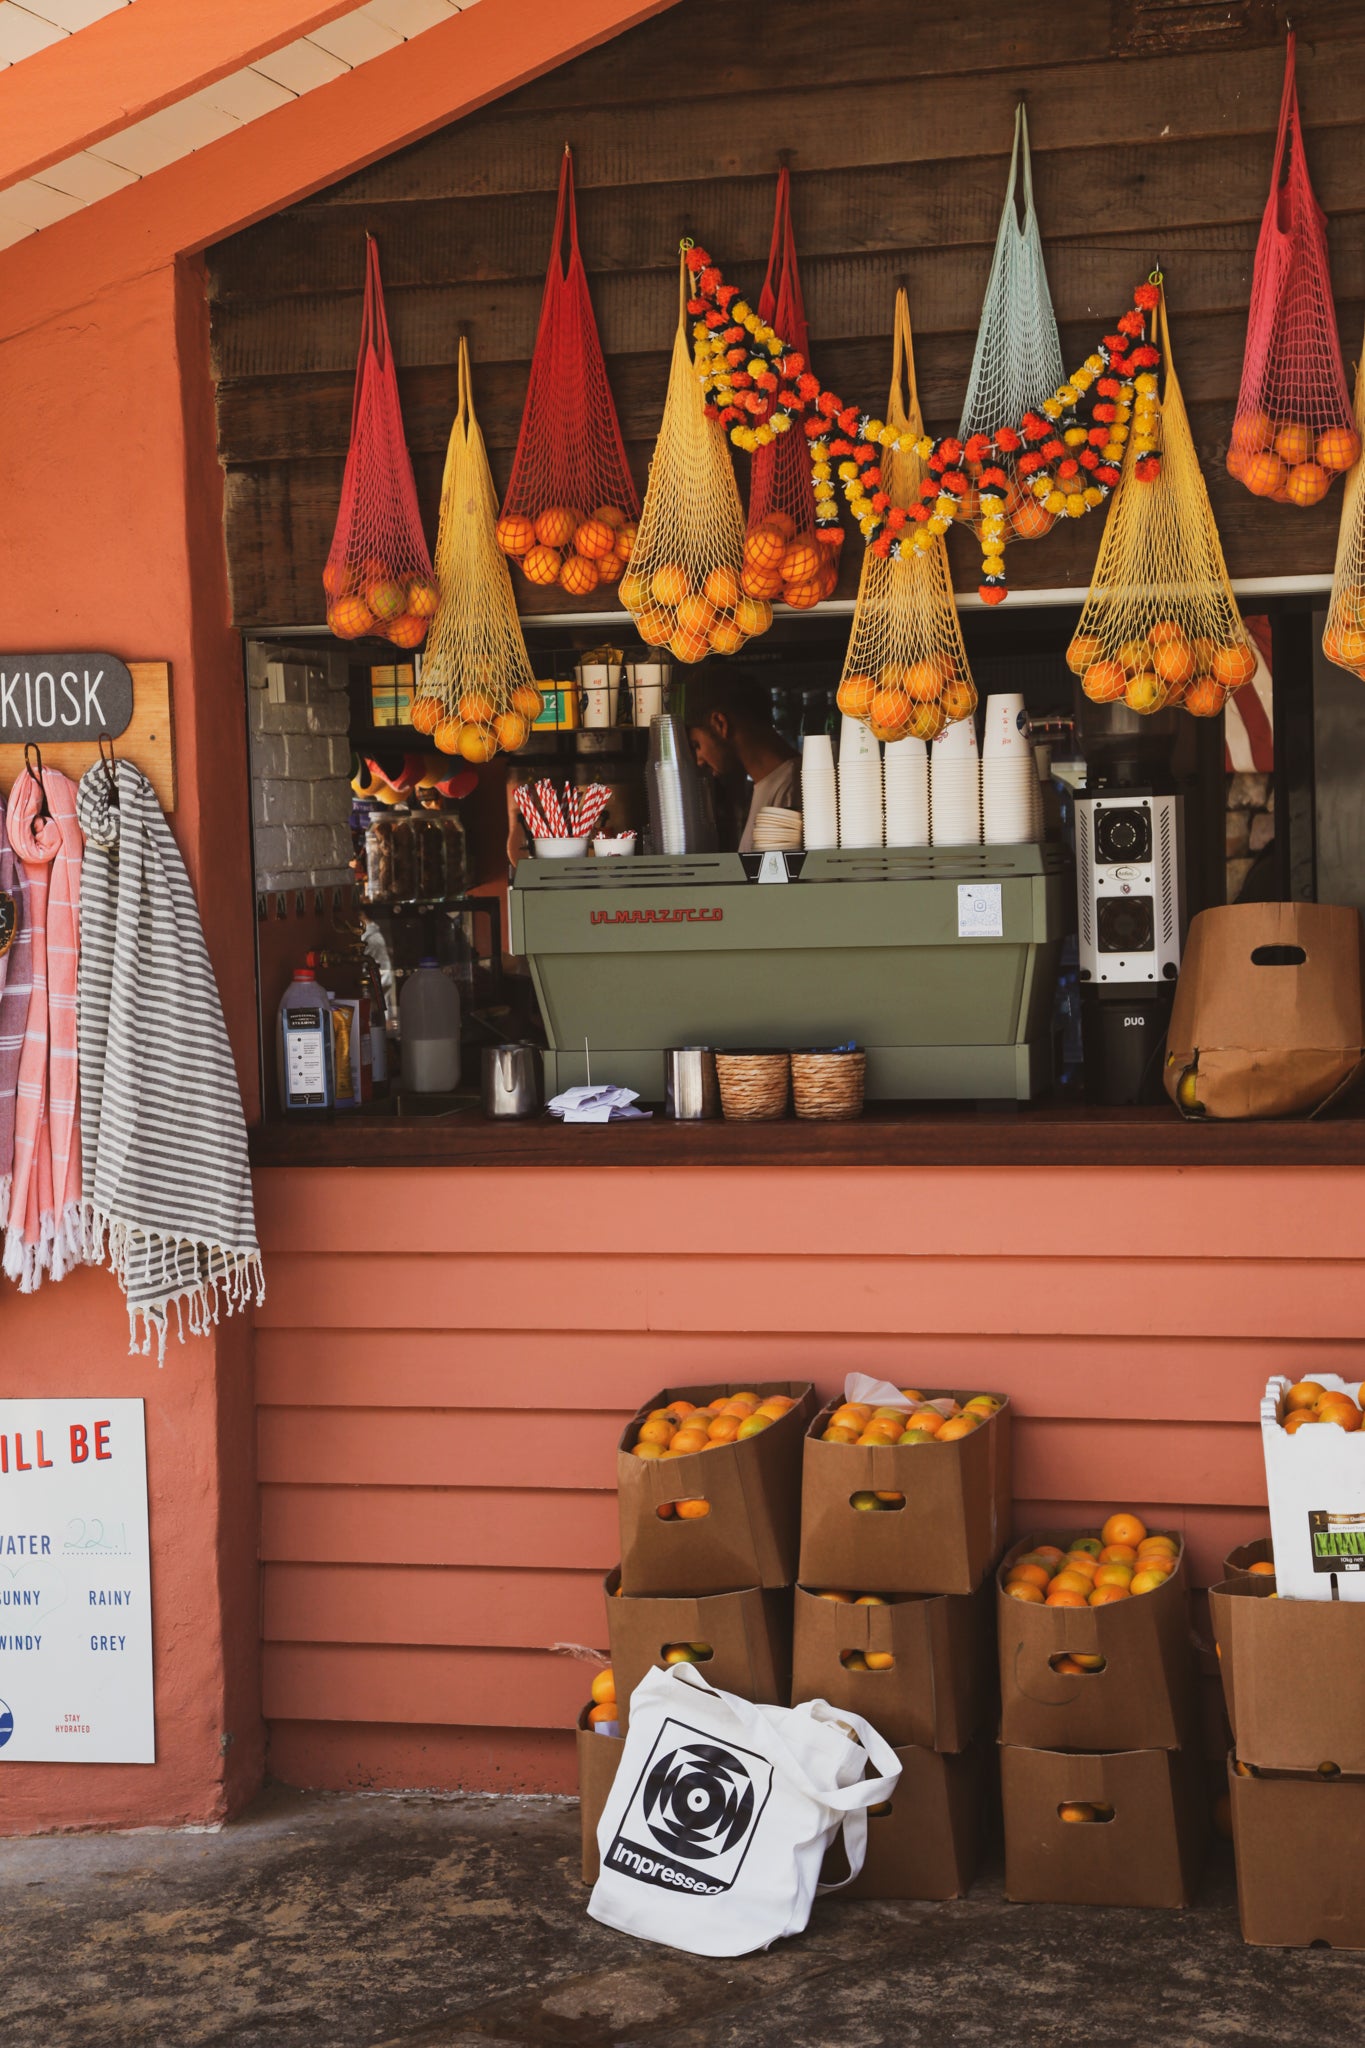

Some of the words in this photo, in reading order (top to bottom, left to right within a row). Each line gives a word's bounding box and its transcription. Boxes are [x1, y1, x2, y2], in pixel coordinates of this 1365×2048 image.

[1, 670, 106, 728] KIOSK
[615, 908, 723, 923] MARZOCCO
[69, 1420, 112, 1464] BE
[0, 1590, 40, 1606] UNNY
[89, 1590, 131, 1606] RAINY
[90, 1635, 126, 1651] GREY
[64, 1714, 80, 1722] STAY
[55, 1724, 90, 1733] HYDRATED
[612, 1842, 724, 1894] Impressed
